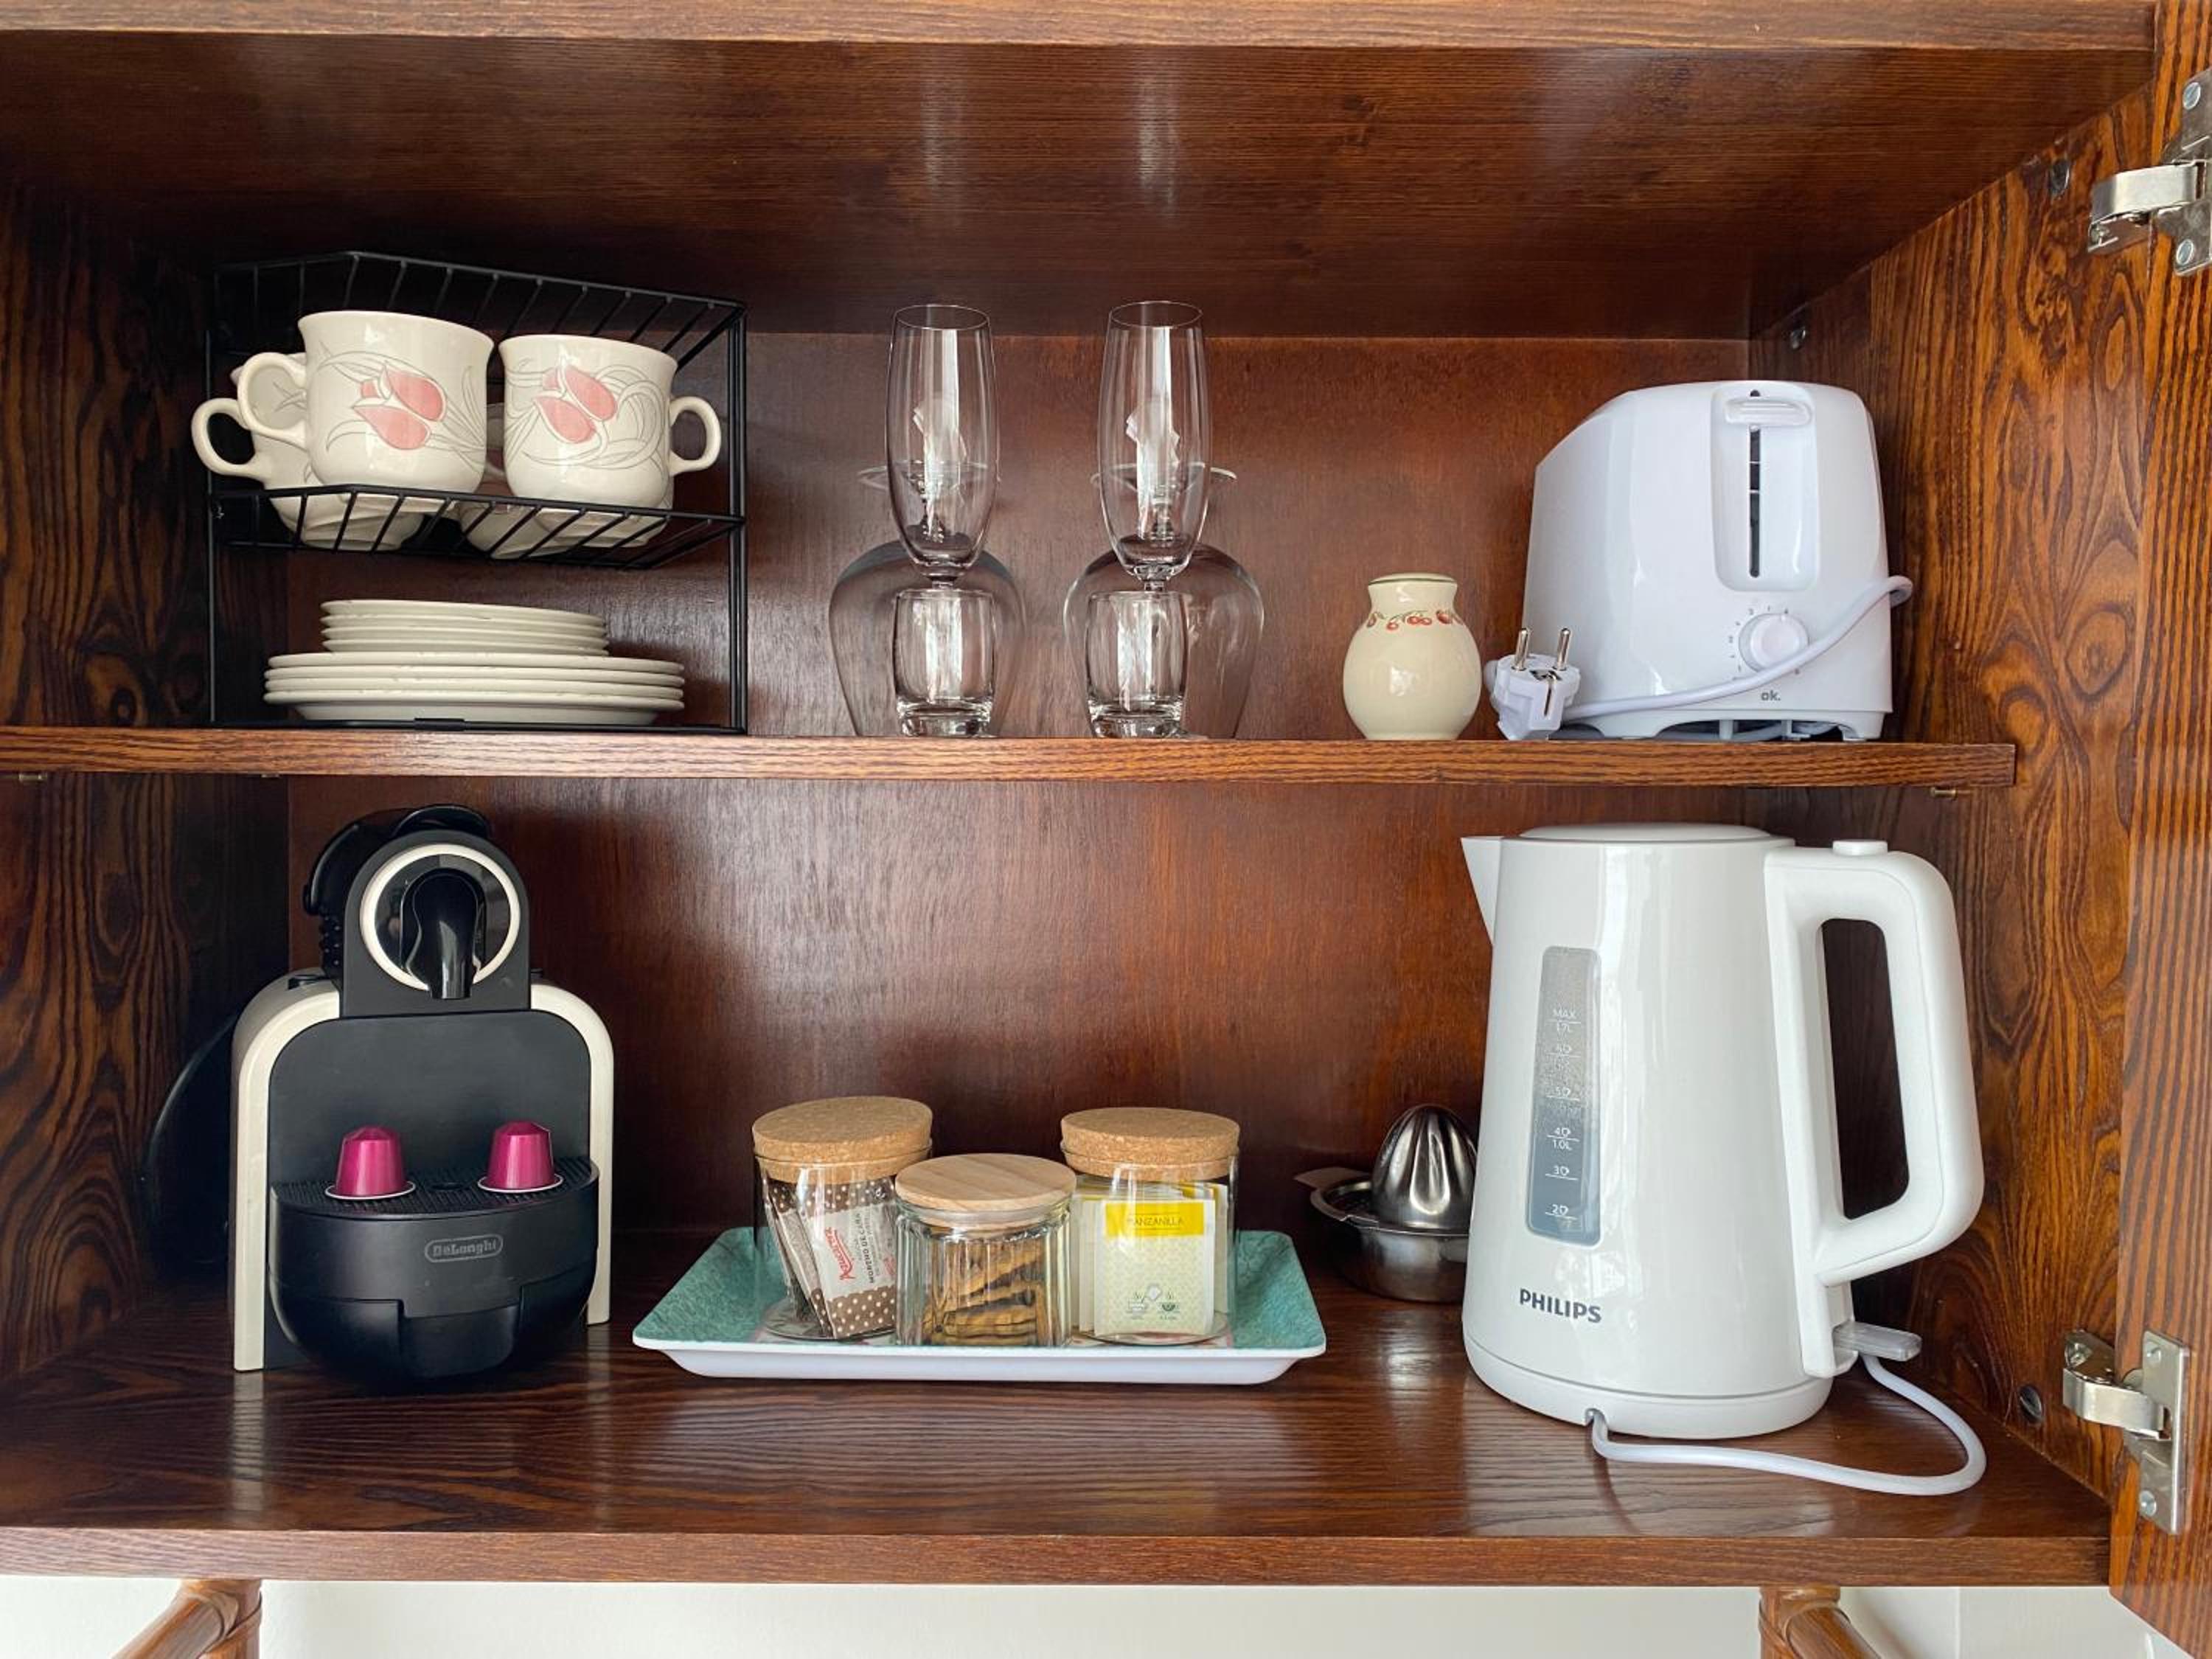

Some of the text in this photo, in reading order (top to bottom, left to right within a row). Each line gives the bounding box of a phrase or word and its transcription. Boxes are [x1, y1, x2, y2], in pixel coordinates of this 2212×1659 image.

[1553, 1008, 1576, 1019] MAX
[863, 1248, 875, 1284] MORENO
[1519, 1287, 1602, 1324] PHILIPS
